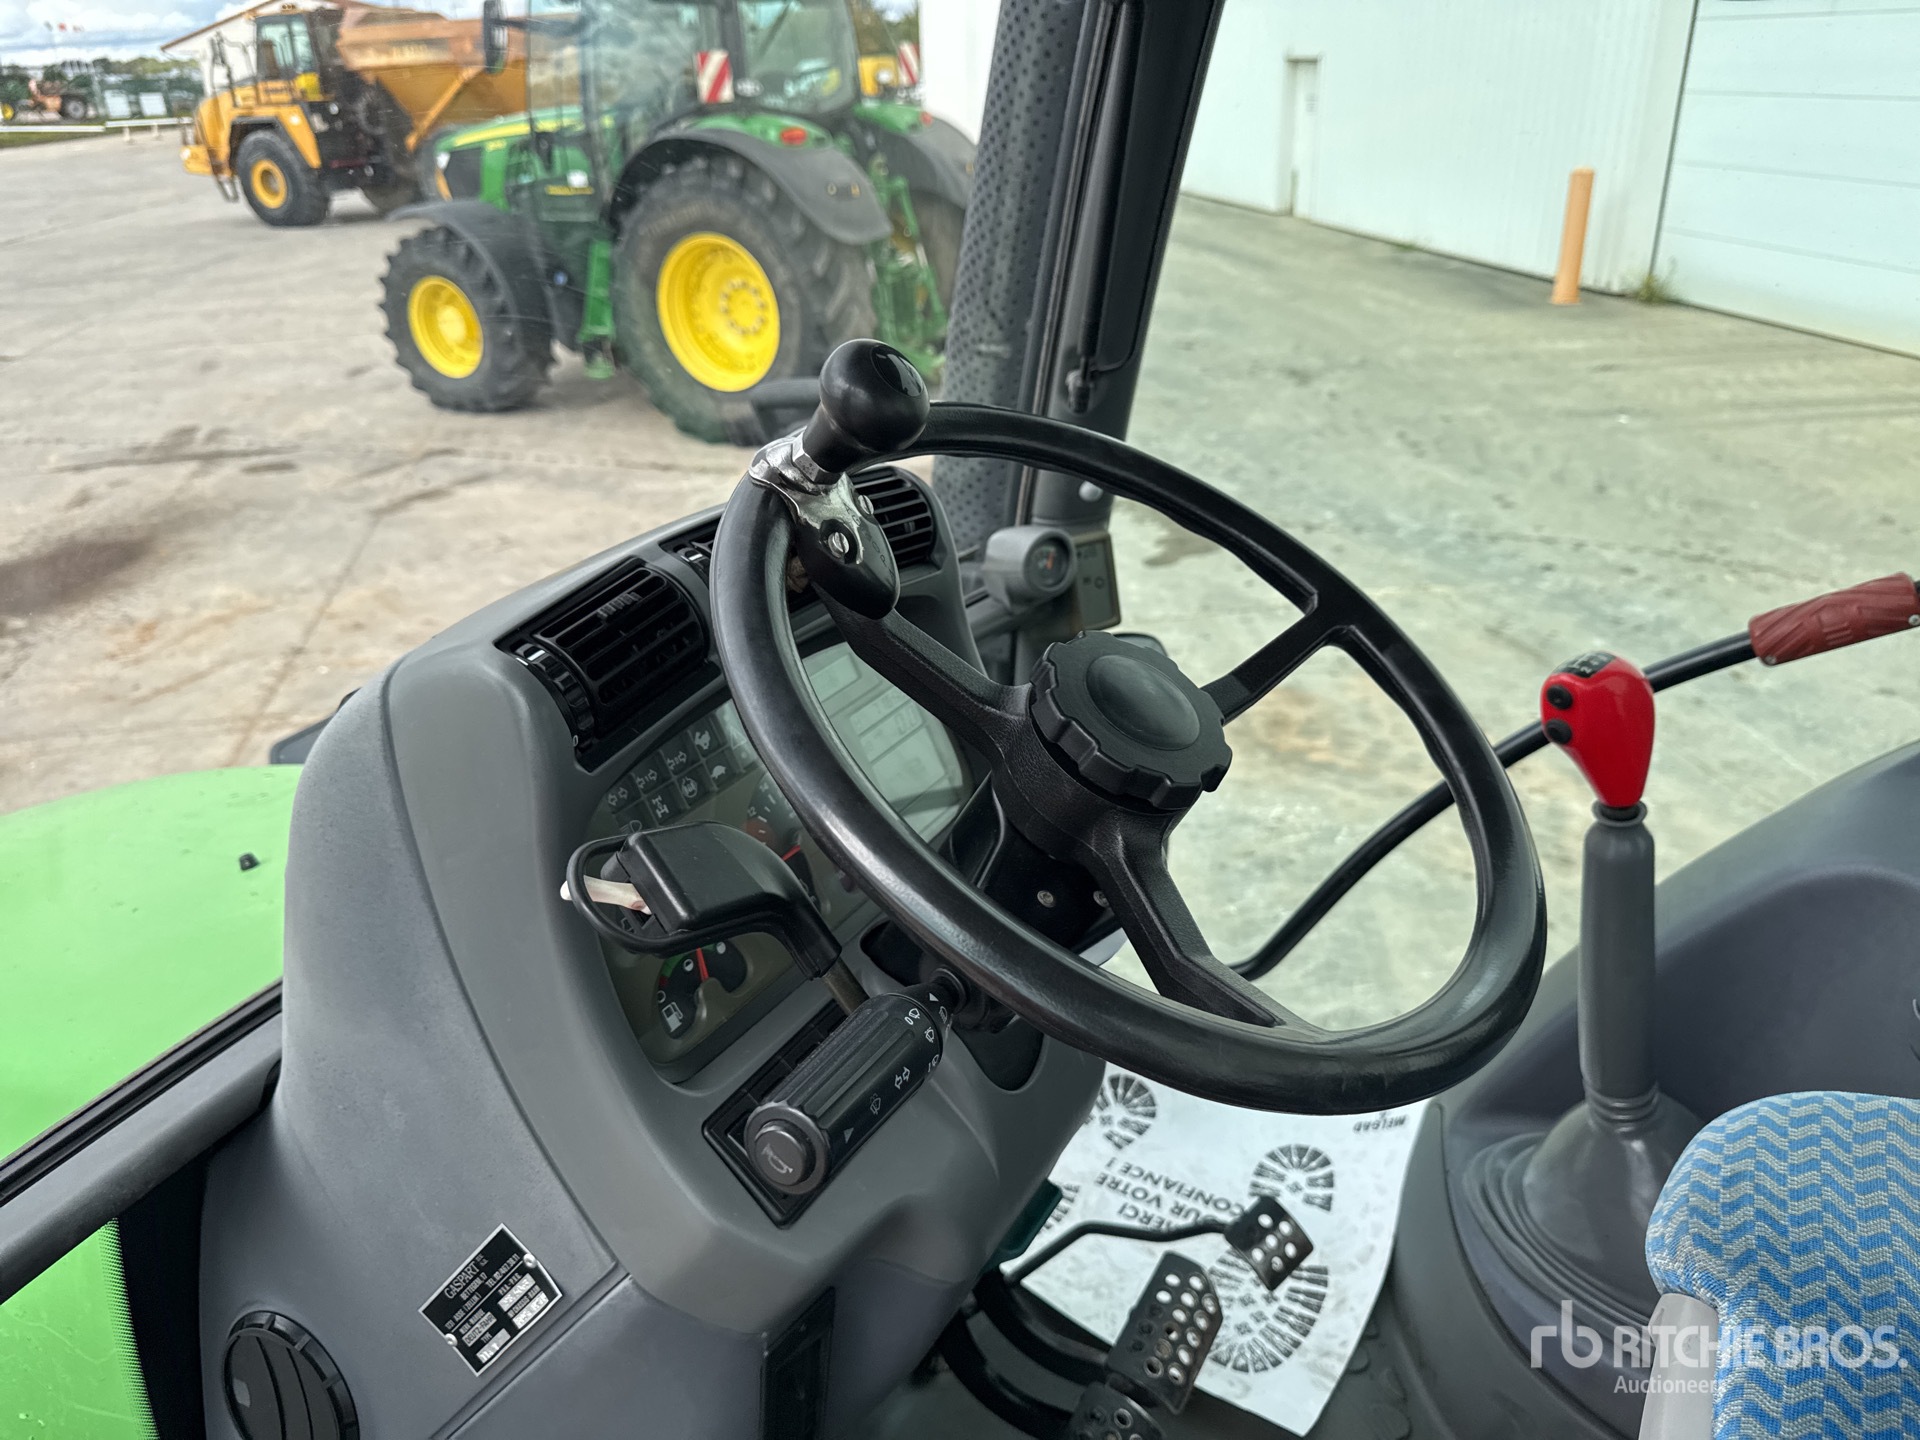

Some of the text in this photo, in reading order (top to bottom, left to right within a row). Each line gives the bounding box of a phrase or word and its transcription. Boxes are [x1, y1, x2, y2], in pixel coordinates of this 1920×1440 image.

[1094, 1172, 1162, 1209] VOTRE
[1119, 1161, 1245, 1216] CONFIANCE
[443, 1261, 480, 1299] GASPART
[464, 1313, 496, 1344] DEUTZ-FAHR
